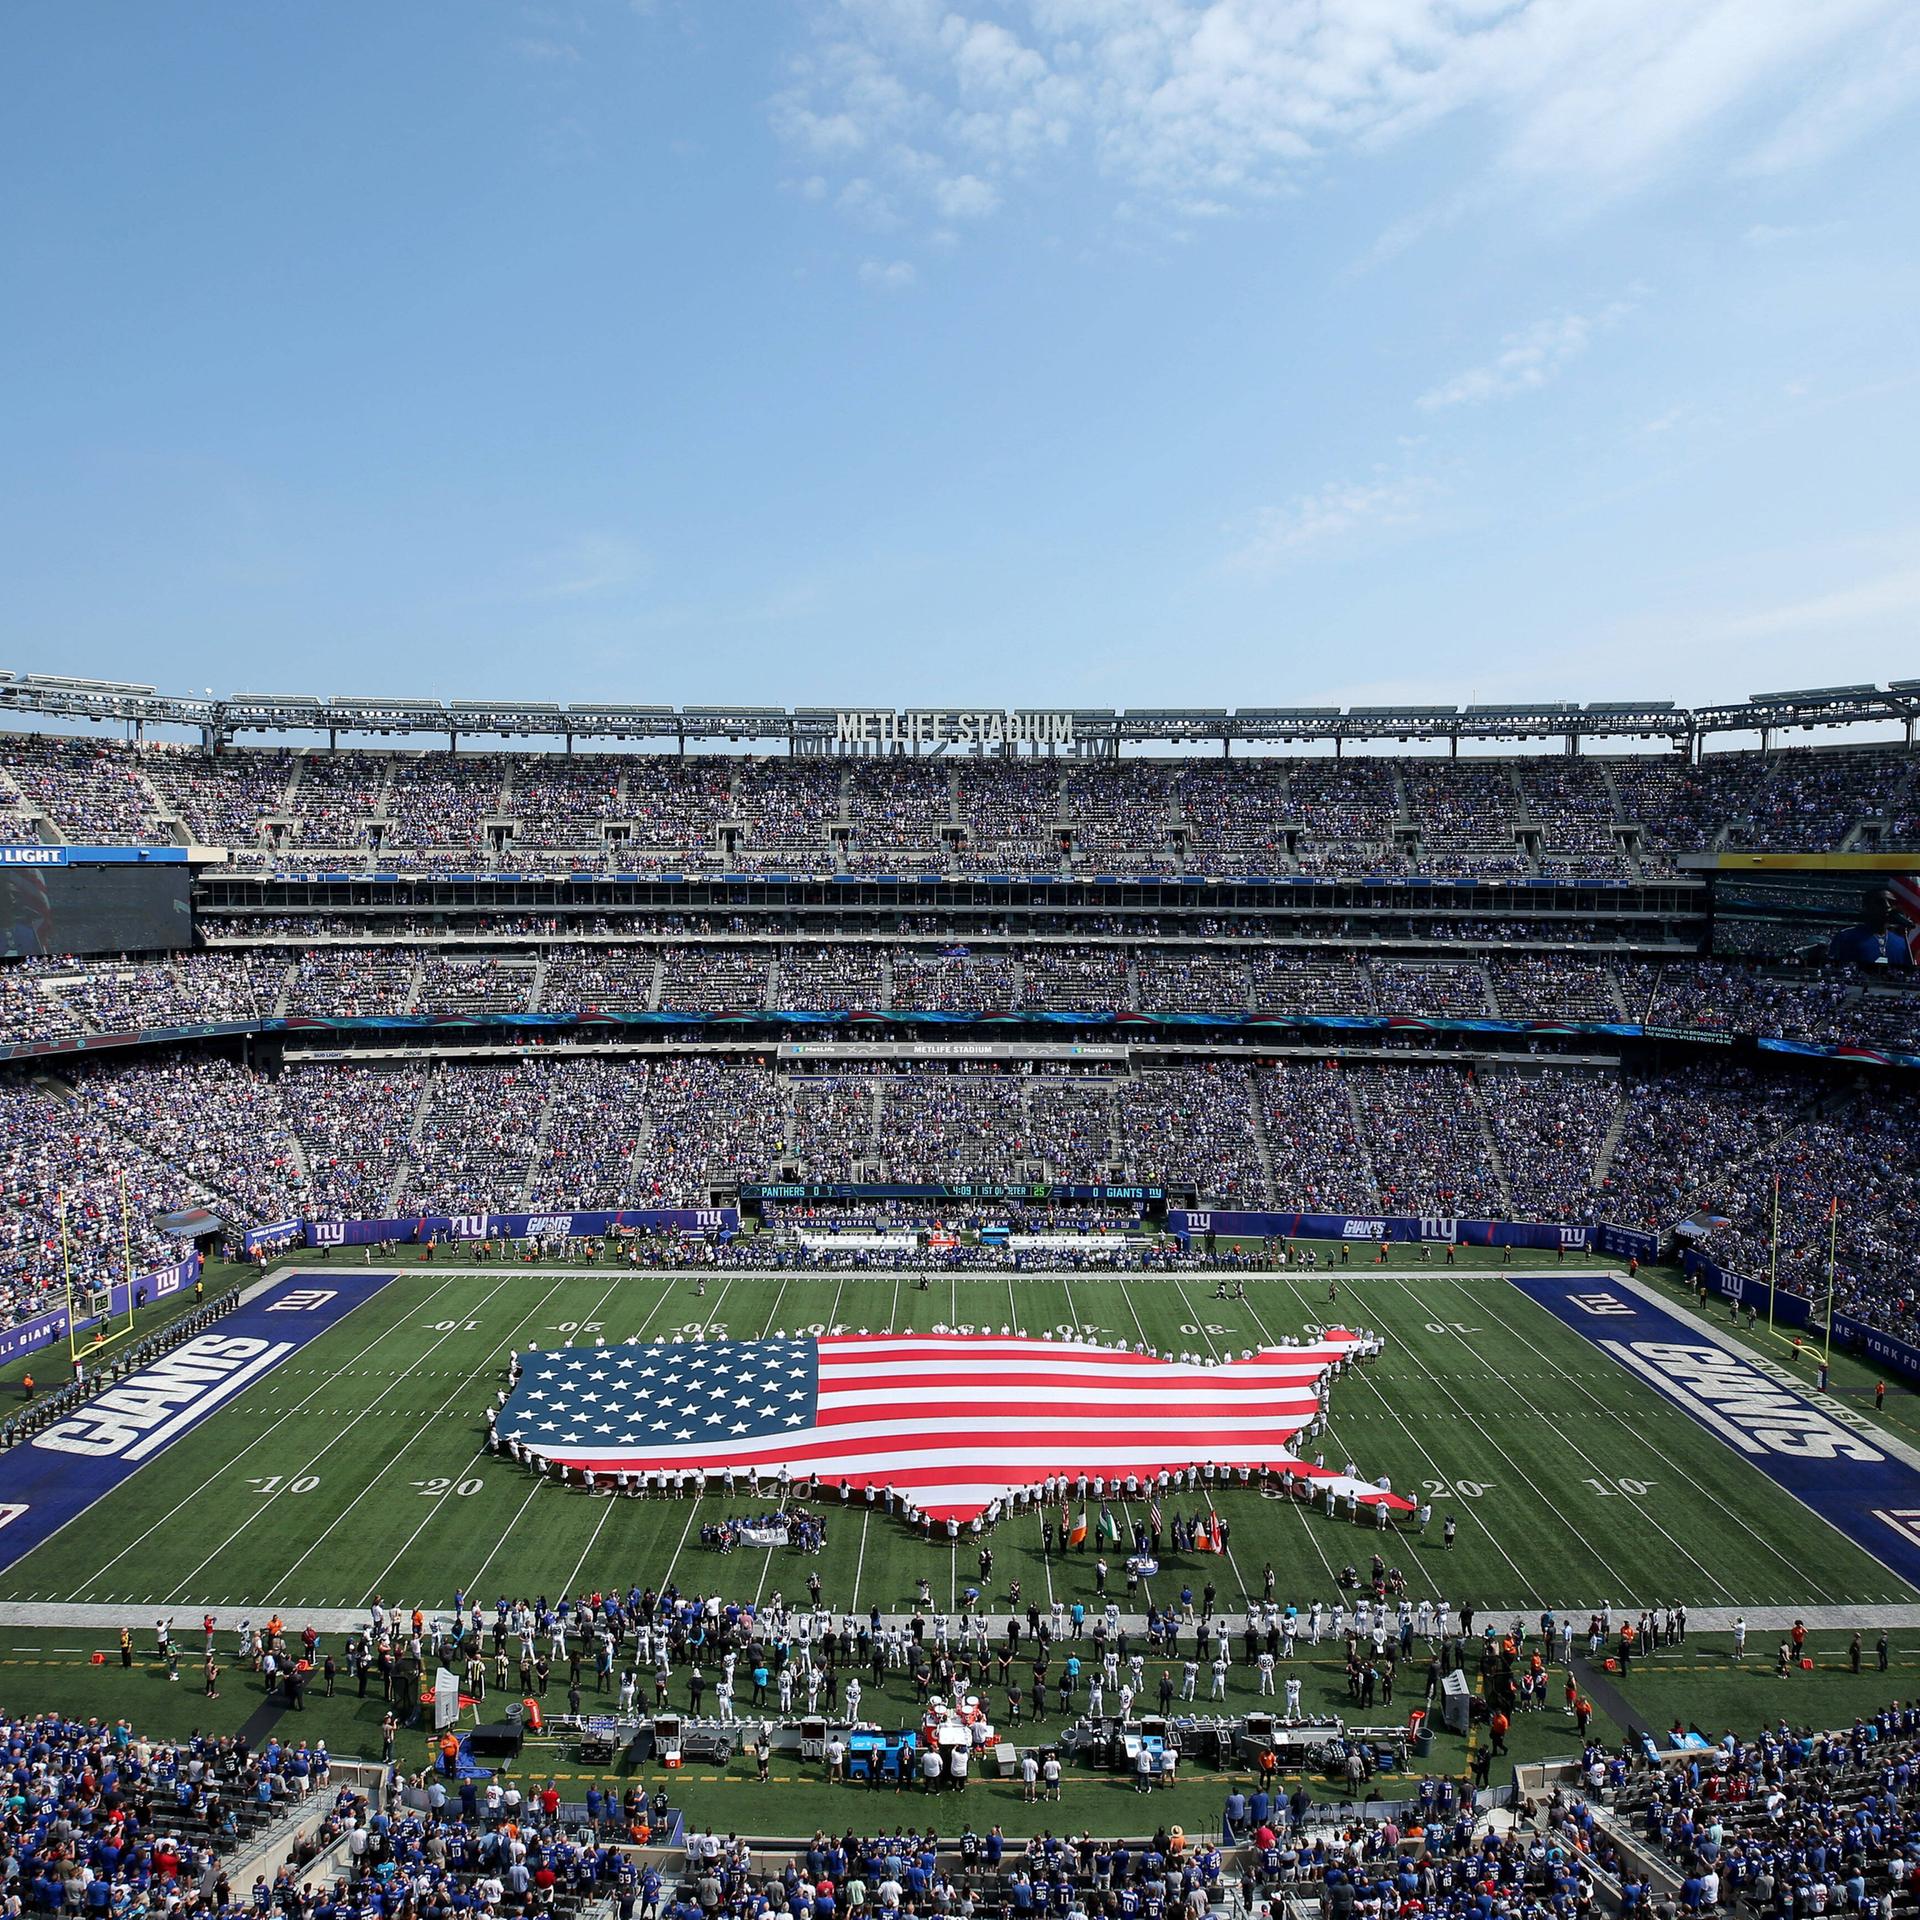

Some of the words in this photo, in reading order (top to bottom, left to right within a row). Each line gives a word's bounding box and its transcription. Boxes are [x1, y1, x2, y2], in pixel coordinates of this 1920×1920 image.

[837, 713, 948, 743] METLIFE
[958, 714, 1073, 743] STADIUM
[5, 849, 61, 862] LIGHT
[762, 1186, 805, 1196] PANTHERS
[813, 1187, 819, 1196] 0
[952, 1187, 971, 1195] 4:09
[982, 1187, 992, 1195] 1ST
[994, 1187, 1026, 1195] QURTER
[1033, 1188, 1044, 1196] 25
[1093, 1188, 1099, 1197] 0
[1106, 1188, 1143, 1198] GIANTS
[526, 1216, 572, 1232] GIANTS
[1187, 1213, 1211, 1231] ny
[1343, 1220, 1386, 1234] GIANTS
[315, 1223, 344, 1245] ny
[449, 1216, 488, 1241] ny
[1419, 1217, 1457, 1243] ny
[1560, 1228, 1586, 1247] ny
[156, 1268, 180, 1297] ny
[1721, 1271, 1743, 1299] ny
[95, 1297, 109, 1310] 25
[1866, 1338, 1898, 1361] YORK
[31, 1334, 271, 1457] GIANTS
[1745, 1358, 1791, 1378] END
[1786, 1383, 1878, 1431] RACISM
[1630, 1341, 1885, 1461] GIANTS
[252, 1475, 320, 1494] 10
[425, 1477, 484, 1497] 20
[1422, 1479, 1485, 1498] 20
[1582, 1477, 1648, 1496] 10
[1262, 1658, 1272, 1667] 82
[718, 1687, 728, 1696] 53
[957, 1686, 963, 1694] 3
[1289, 1685, 1298, 1693] 75
[848, 1691, 858, 1699] 42
[1124, 1695, 1129, 1703] 2
[1444, 1789, 1452, 1799] 11
[451, 1846, 461, 1857] 10
[688, 1842, 694, 1850] 8
[1210, 1857, 1221, 1869] 56
[1268, 1857, 1278, 1866] 10
[618, 1874, 631, 1884] 89
[731, 1874, 740, 1882] 10
[1036, 1890, 1047, 1900] 26
[1060, 1894, 1069, 1904] 11
[1122, 1900, 1134, 1912] 10
[1149, 1907, 1158, 1916] 10
